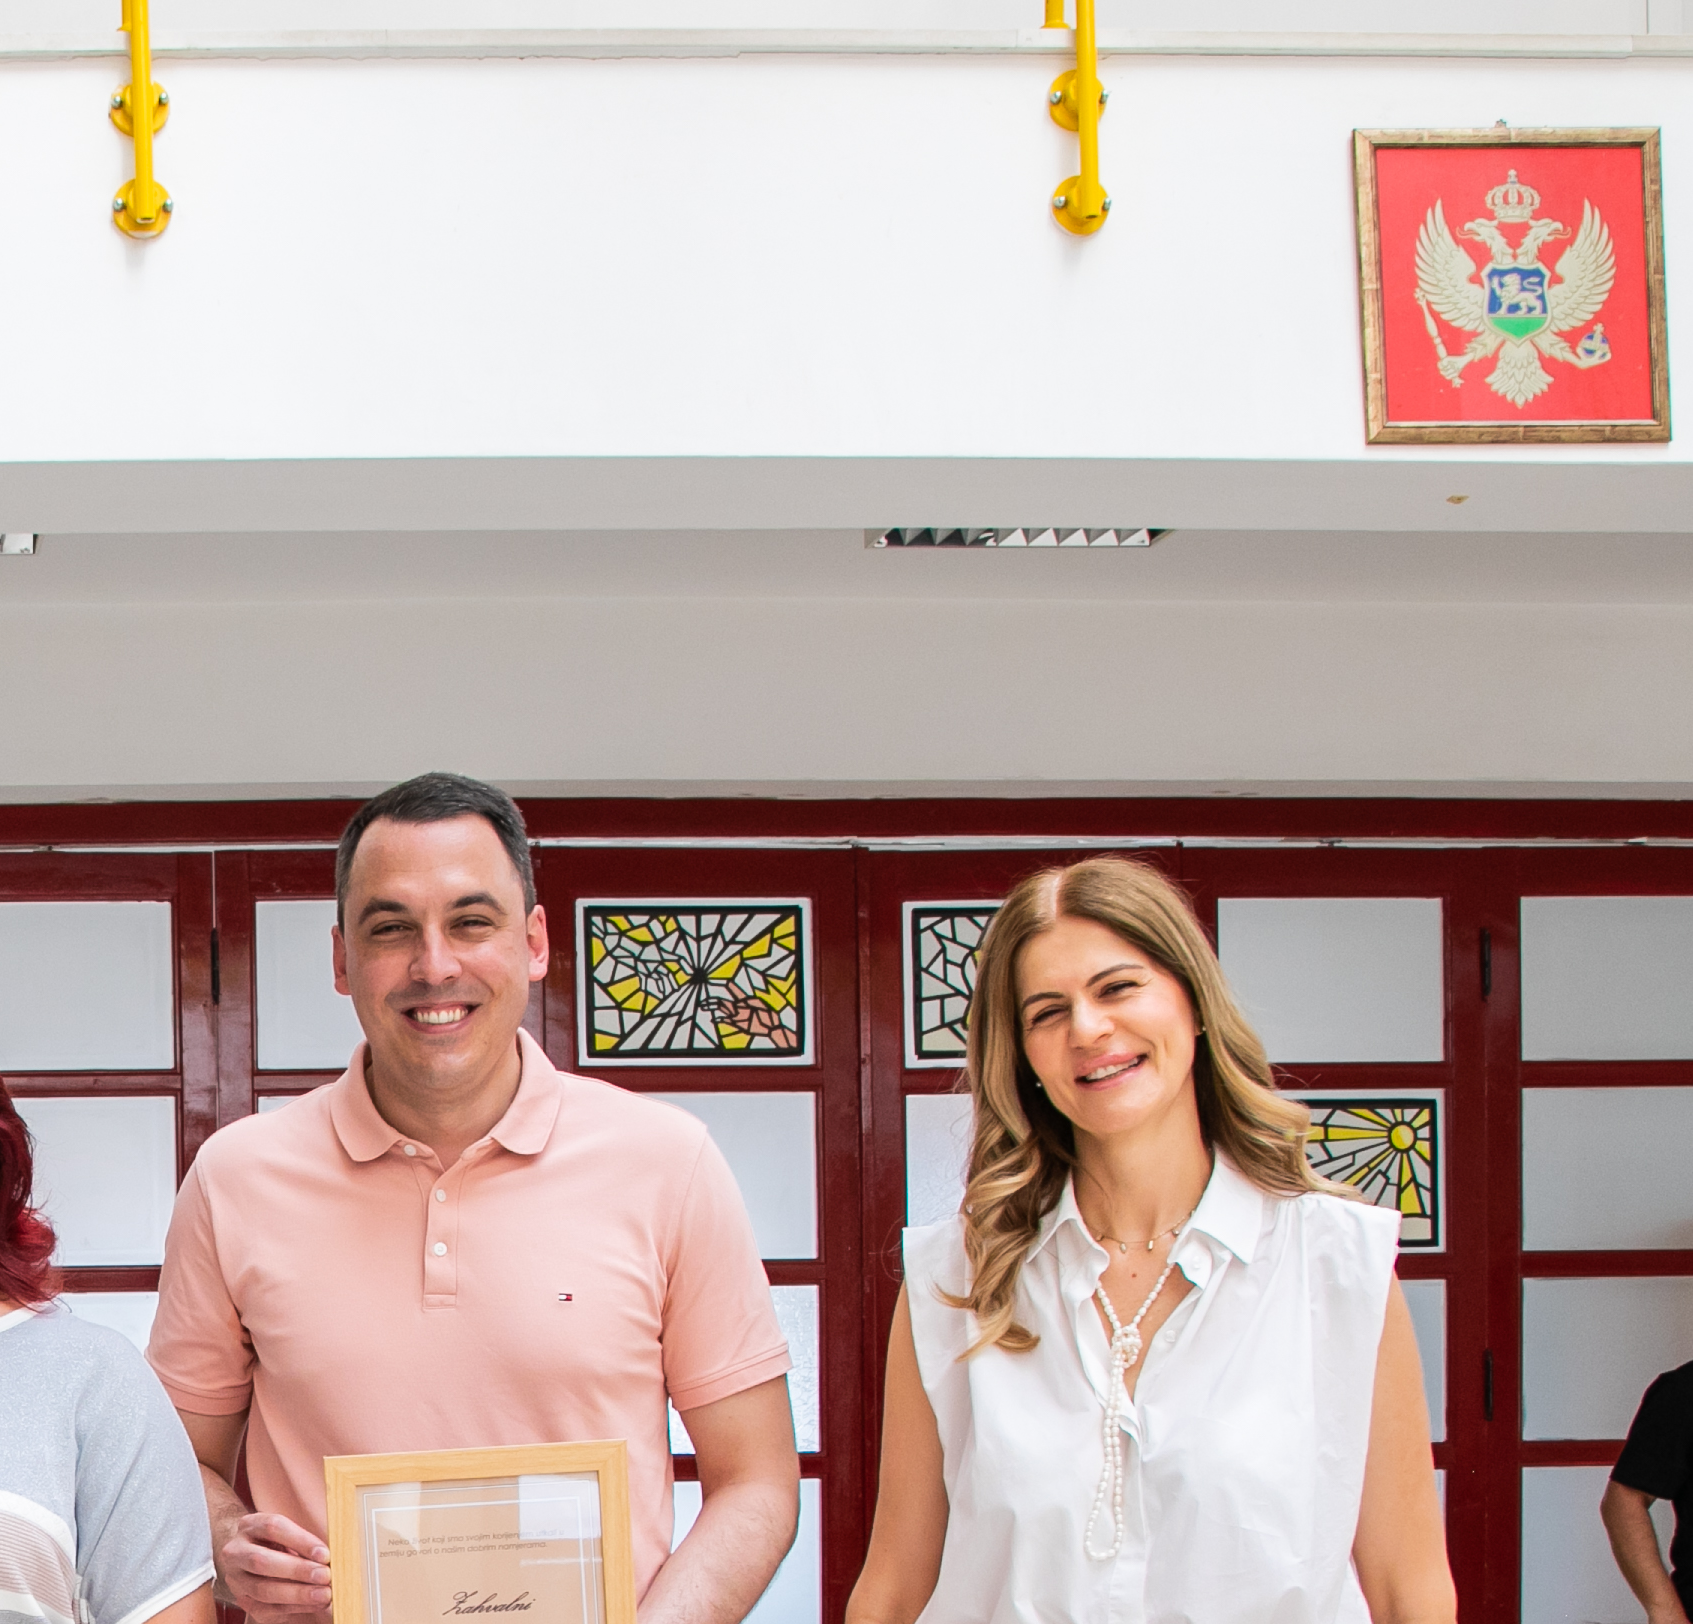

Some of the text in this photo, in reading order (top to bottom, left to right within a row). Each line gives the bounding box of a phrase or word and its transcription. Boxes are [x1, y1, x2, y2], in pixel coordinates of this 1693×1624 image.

[432, 1535, 446, 1545] koji
[465, 1533, 491, 1542] svojim
[379, 1549, 405, 1558] zemlju
[406, 1547, 432, 1557] govori
[441, 1545, 466, 1554] našim
[467, 1543, 497, 1552] dobrim
[498, 1541, 548, 1551] namjerama.
[442, 1590, 536, 1616] Zahvalni
